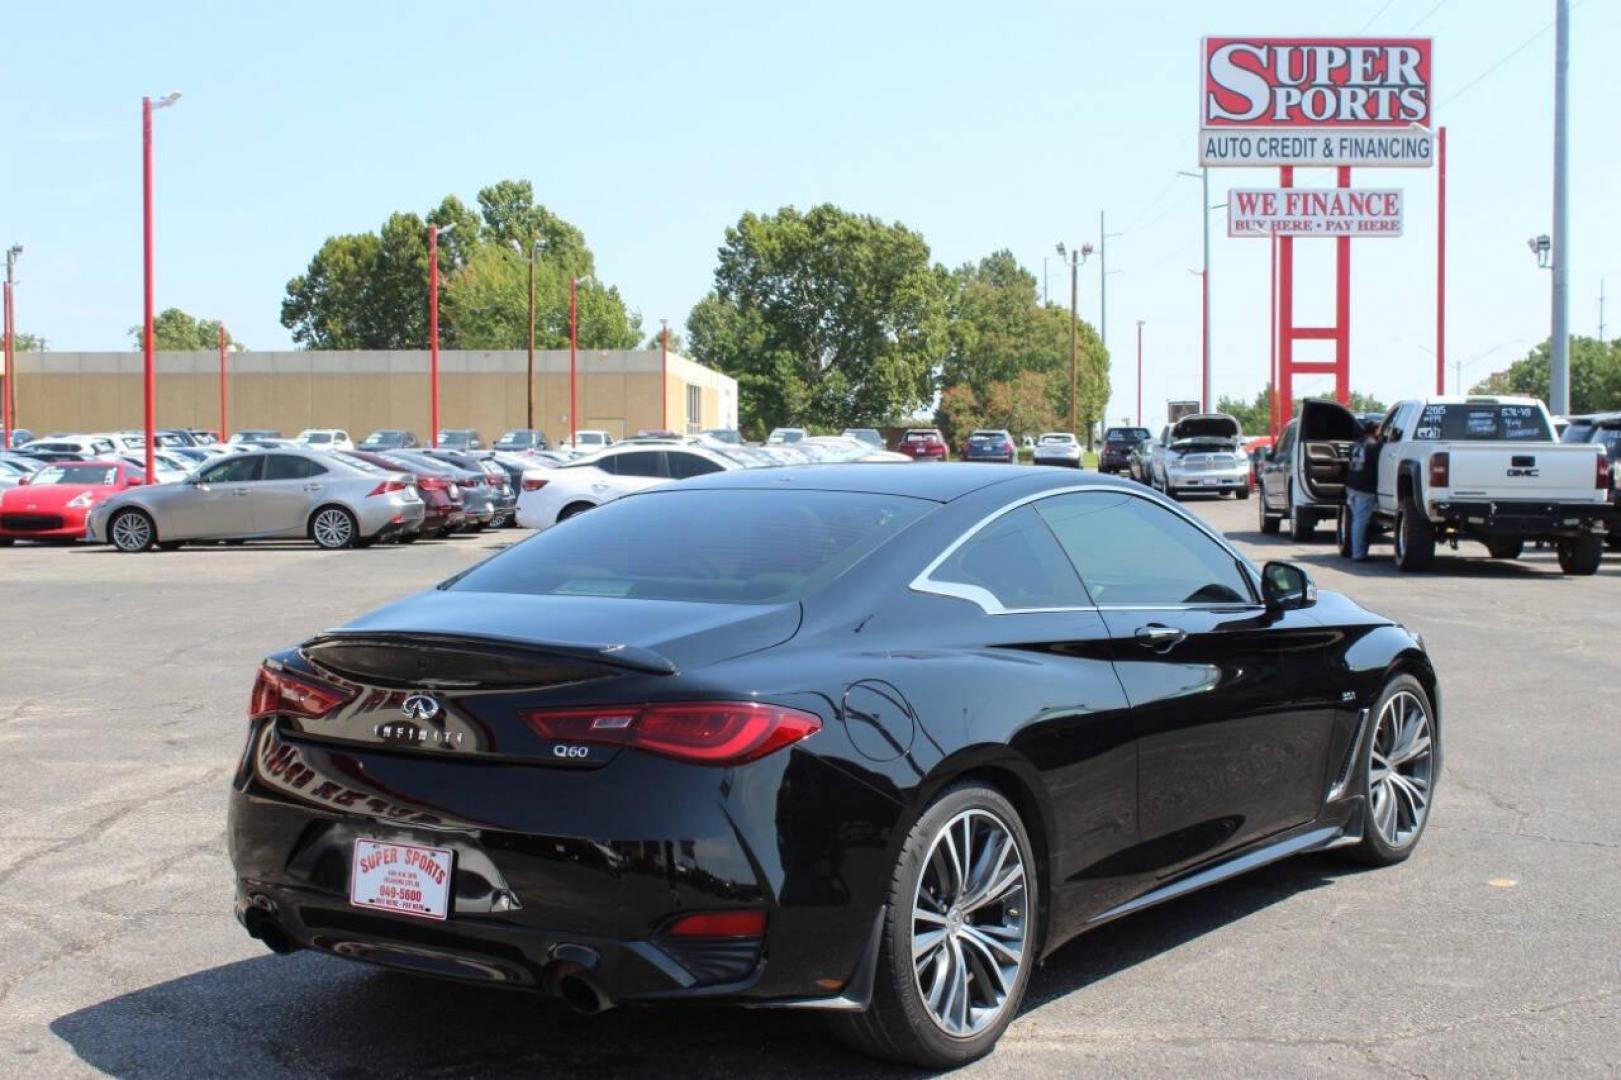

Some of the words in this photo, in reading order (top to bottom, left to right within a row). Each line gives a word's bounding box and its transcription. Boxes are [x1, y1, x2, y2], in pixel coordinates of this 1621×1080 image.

[1205, 138, 1251, 159] AUTO
[1256, 137, 1318, 159] CREDIT
[1322, 138, 1334, 158] &
[1339, 138, 1431, 159] FINANCING
[1236, 192, 1278, 216] WE
[1284, 192, 1400, 217] FINANCE
[1235, 220, 1266, 231] BUY
[1271, 220, 1313, 231] HERE
[1325, 220, 1354, 231] PAY
[1358, 220, 1400, 231] HERE
[1506, 469, 1540, 477] GMC
[374, 725, 463, 742] INFINITI
[553, 745, 589, 758] Q60
[360, 848, 398, 874] SUPER
[404, 848, 446, 885] SPORTS
